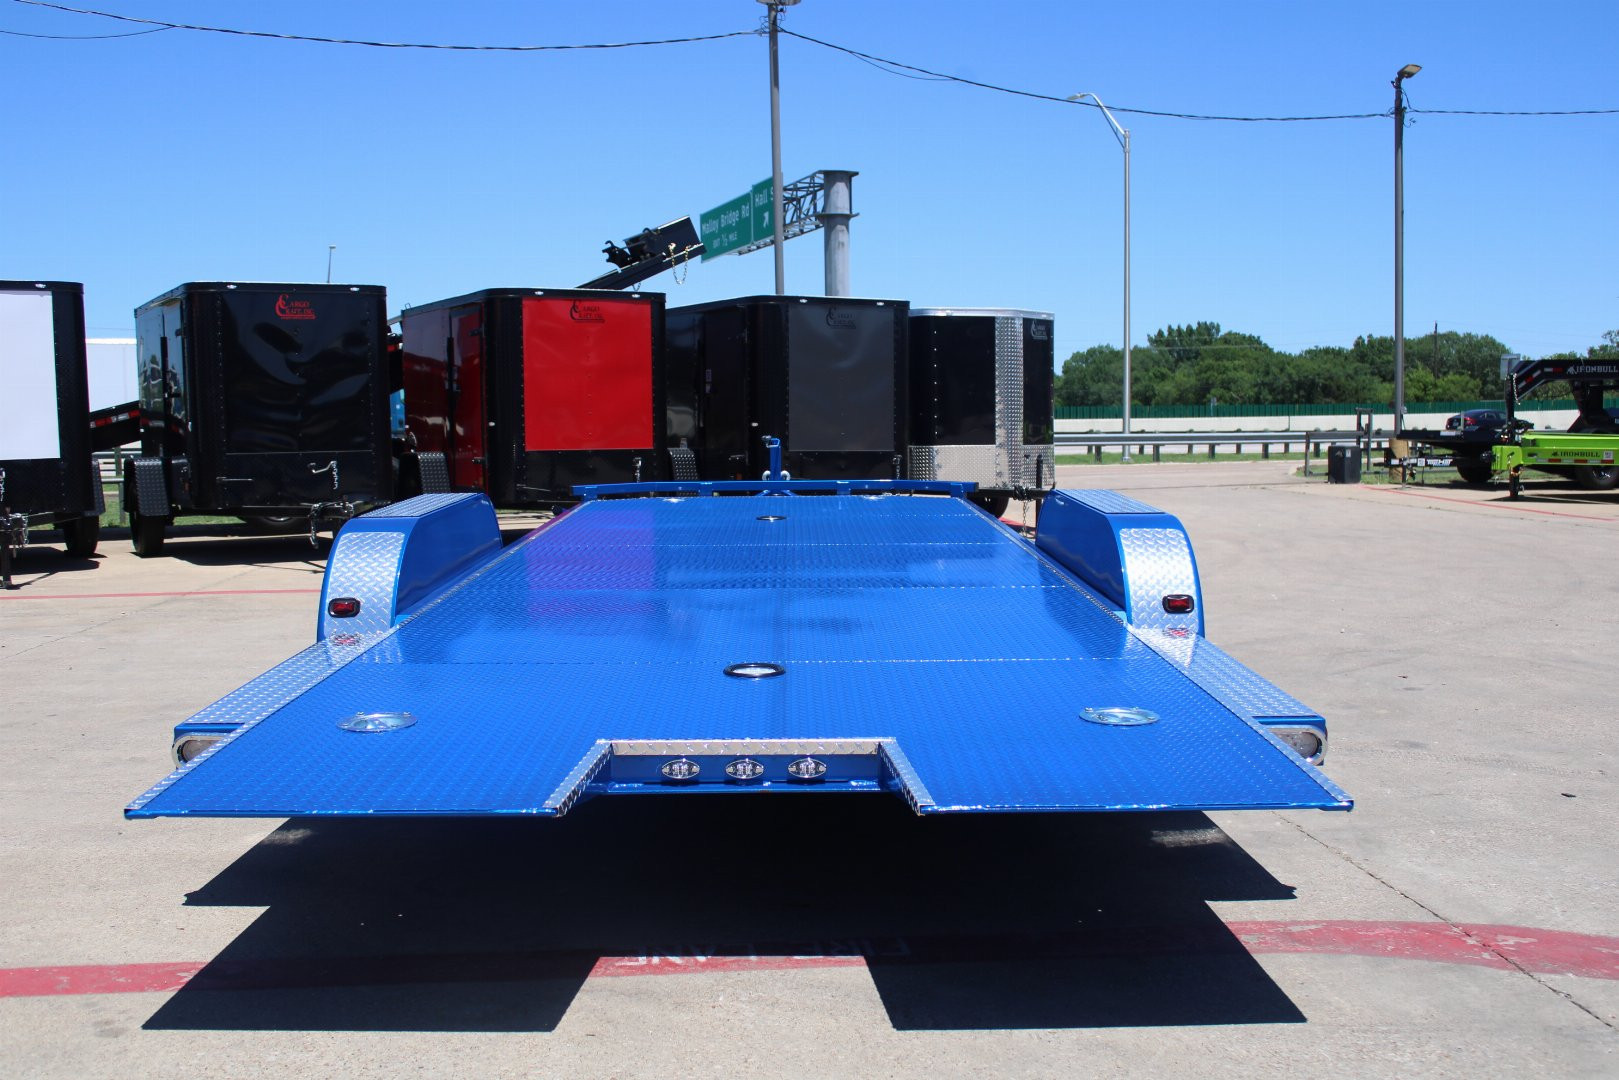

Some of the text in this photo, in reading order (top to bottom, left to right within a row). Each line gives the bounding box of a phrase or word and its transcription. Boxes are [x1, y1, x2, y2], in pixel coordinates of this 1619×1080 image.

[755, 189, 768, 208] Hall
[720, 210, 740, 228] Bridge
[741, 203, 750, 219] Rd
[1576, 365, 1619, 373] IRONBULL
